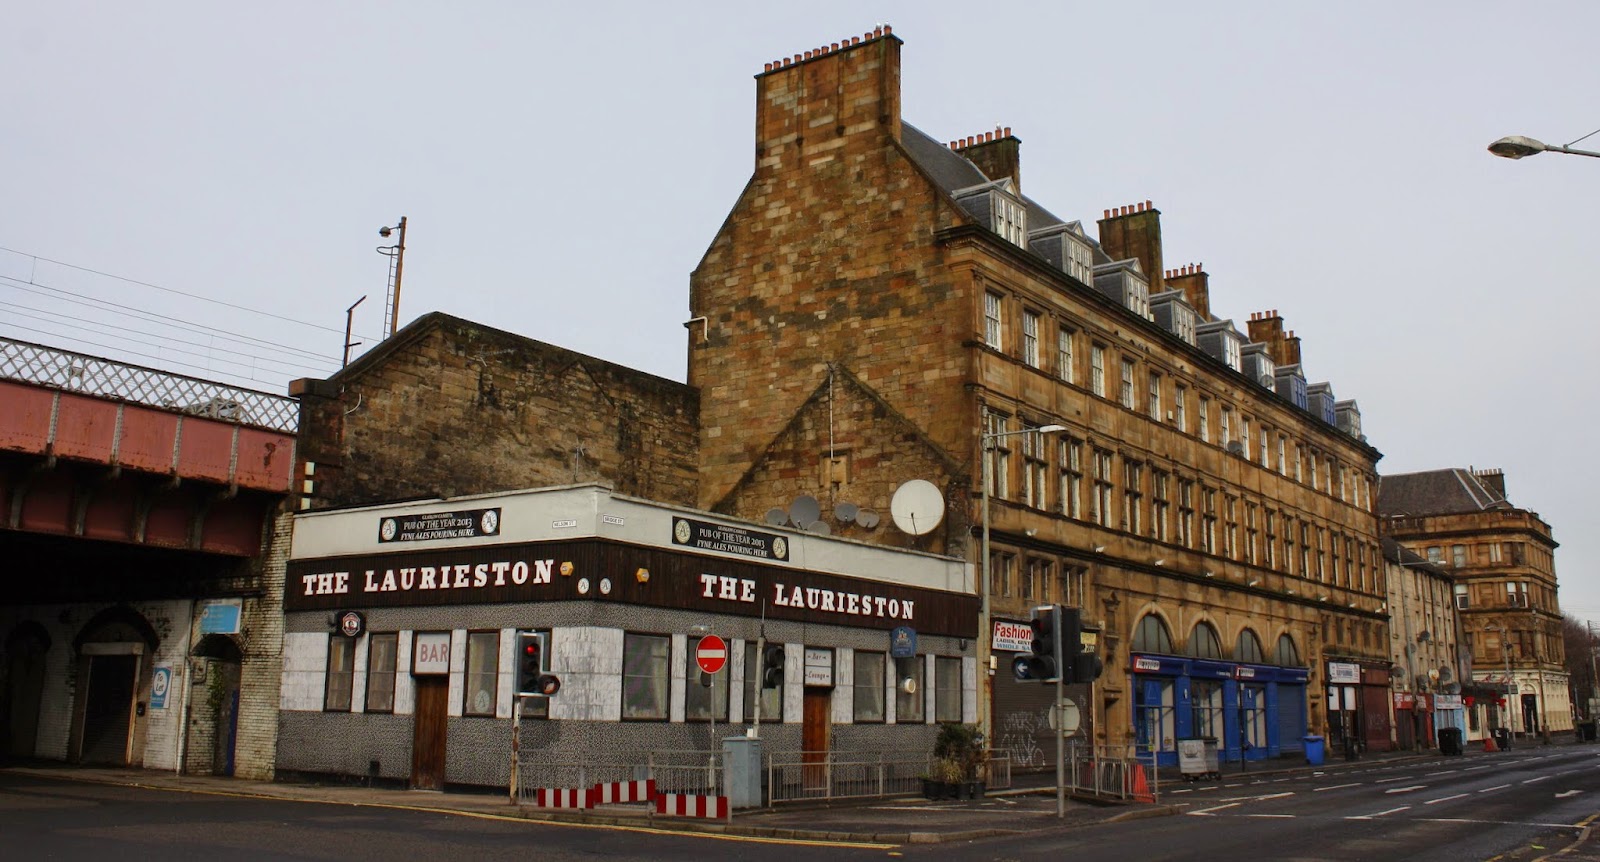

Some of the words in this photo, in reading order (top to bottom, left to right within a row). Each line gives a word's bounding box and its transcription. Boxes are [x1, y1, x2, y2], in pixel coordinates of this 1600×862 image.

[403, 521, 416, 531] PUB
[416, 520, 425, 530] OF
[426, 519, 440, 529] THE
[440, 519, 456, 528] YEAR
[457, 518, 473, 528] 2013
[401, 532, 415, 541] FYNE
[415, 531, 430, 540] ALES
[430, 529, 457, 539] POURING
[458, 528, 474, 537] HERE
[699, 528, 712, 538] PUB
[712, 530, 721, 540] OF
[721, 532, 735, 542] THE
[735, 534, 751, 545] YEAR
[751, 538, 765, 549] 2013
[696, 539, 713, 549] FYNE
[712, 542, 727, 551] ALES
[727, 544, 753, 556] POURING
[752, 549, 768, 558] HERE
[303, 571, 349, 596] THE
[364, 559, 554, 593] LAURIESTON
[700, 573, 756, 602] THE
[774, 583, 915, 620] LAURIESTON
[994, 622, 1032, 640] Fashion
[420, 643, 448, 662] BAR
[812, 652, 821, 660] Bar
[157, 673, 164, 681] To
[808, 671, 826, 680] Lounge
[155, 684, 164, 692] Let
